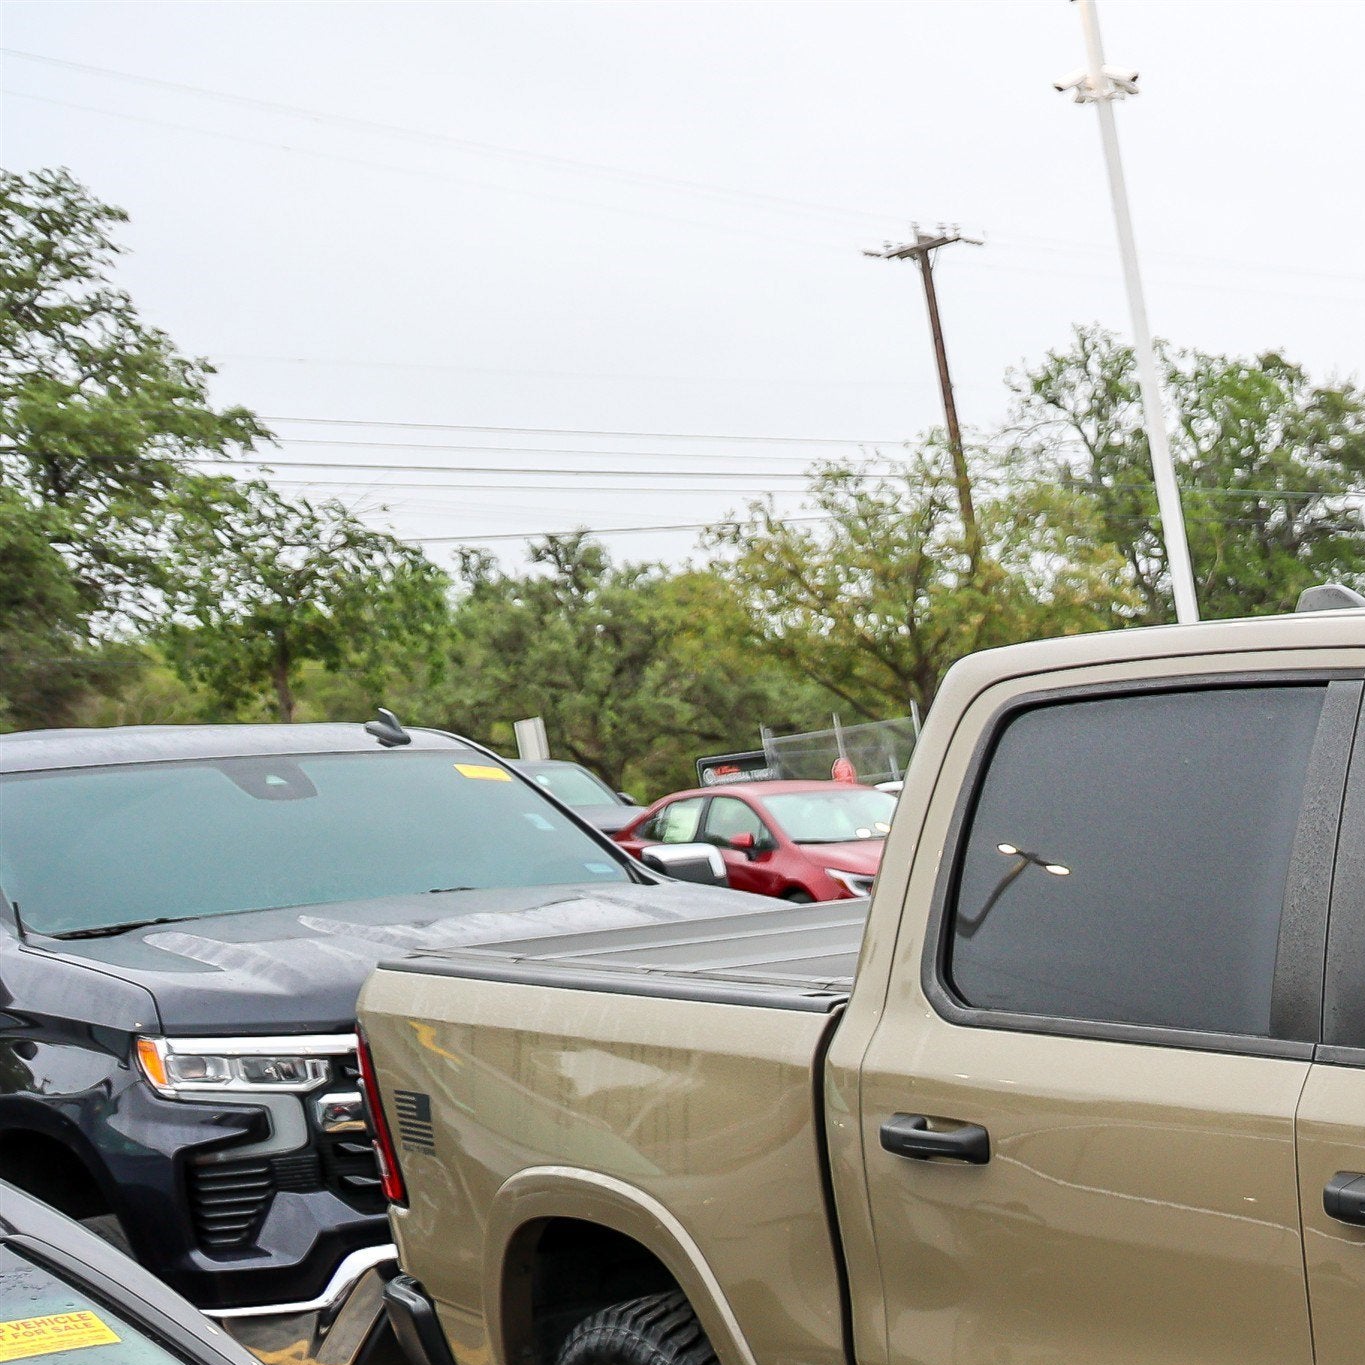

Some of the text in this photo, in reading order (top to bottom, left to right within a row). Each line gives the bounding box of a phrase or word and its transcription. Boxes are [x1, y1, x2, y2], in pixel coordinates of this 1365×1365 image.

[7, 1312, 92, 1331] VEHICLE
[11, 1328, 46, 1340] FOR
[51, 1322, 96, 1333] SALE
